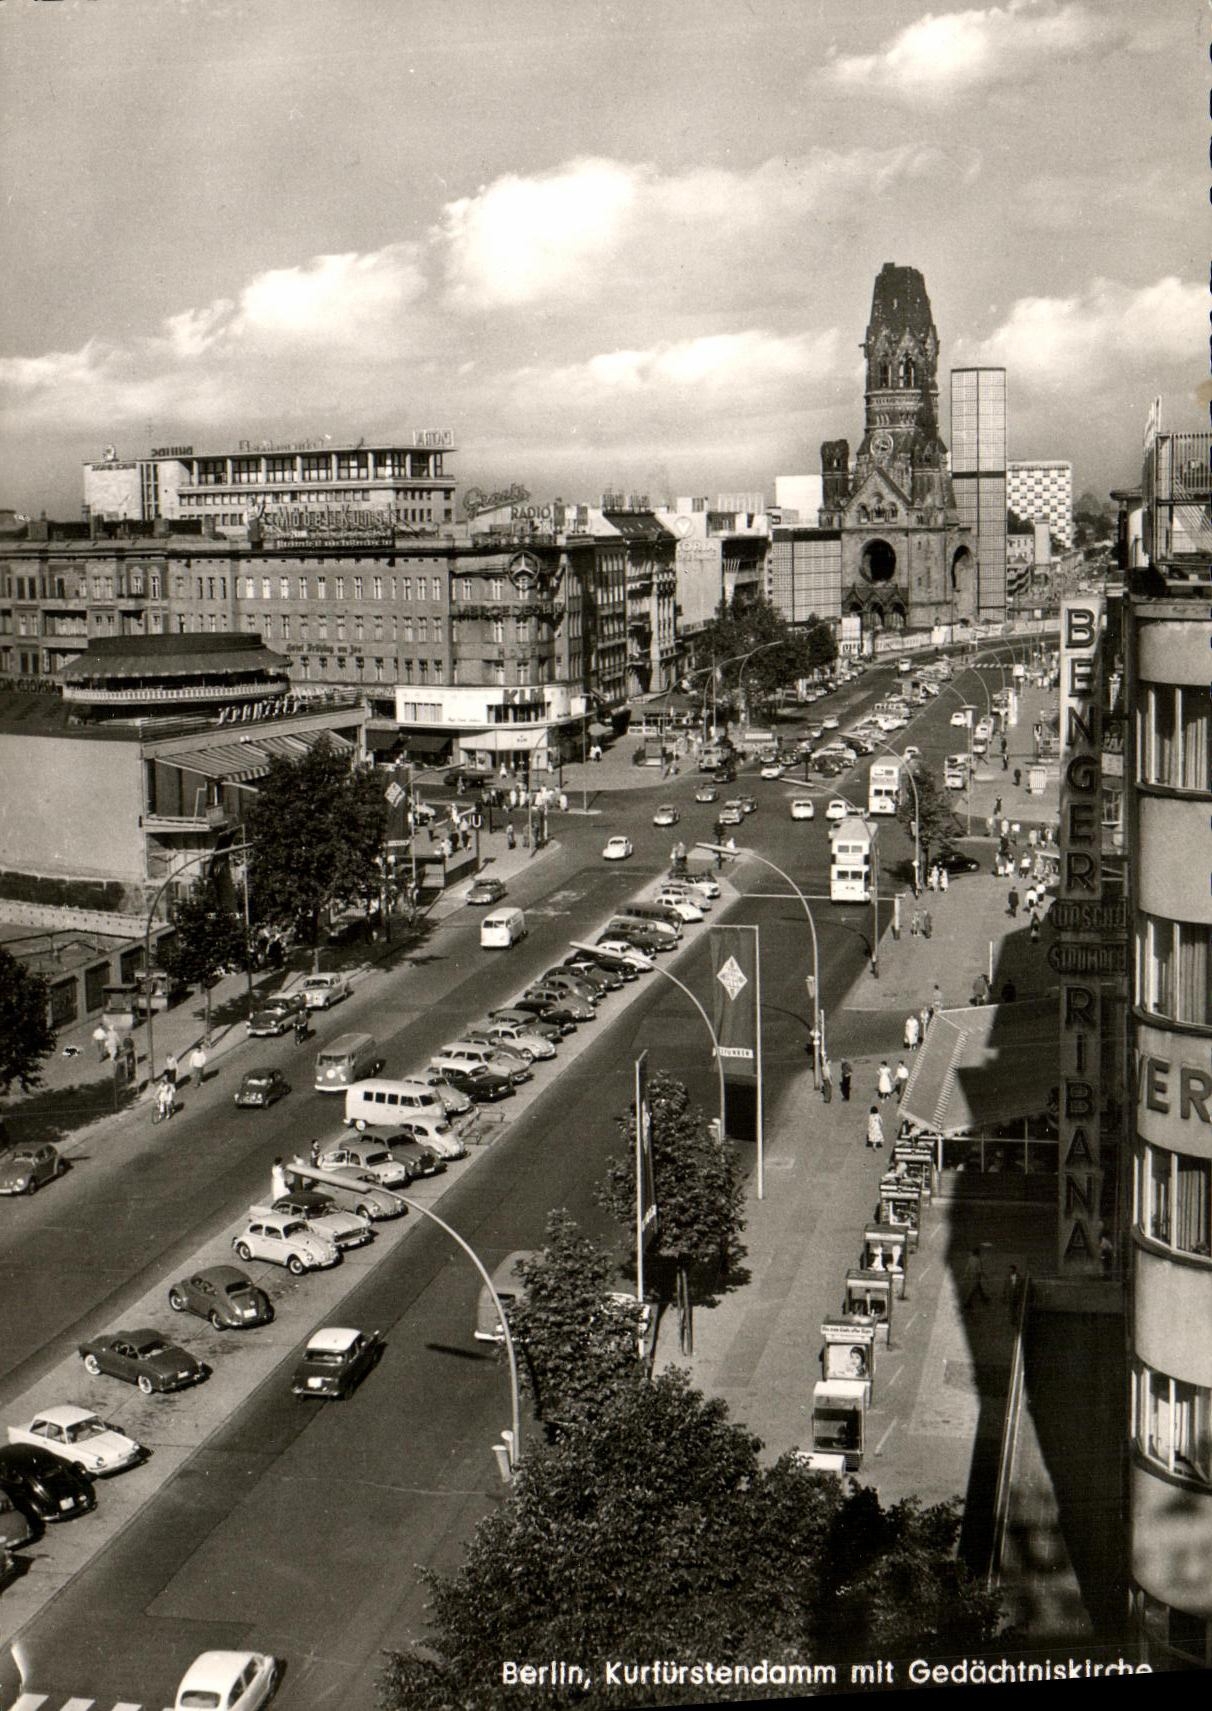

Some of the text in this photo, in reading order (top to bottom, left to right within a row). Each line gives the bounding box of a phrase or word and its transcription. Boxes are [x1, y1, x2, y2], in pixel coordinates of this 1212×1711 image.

[511, 505, 551, 520] RADIO
[503, 689, 545, 704] KLM
[1064, 608, 1096, 890] BENGER
[1063, 984, 1096, 1260] RIBANA
